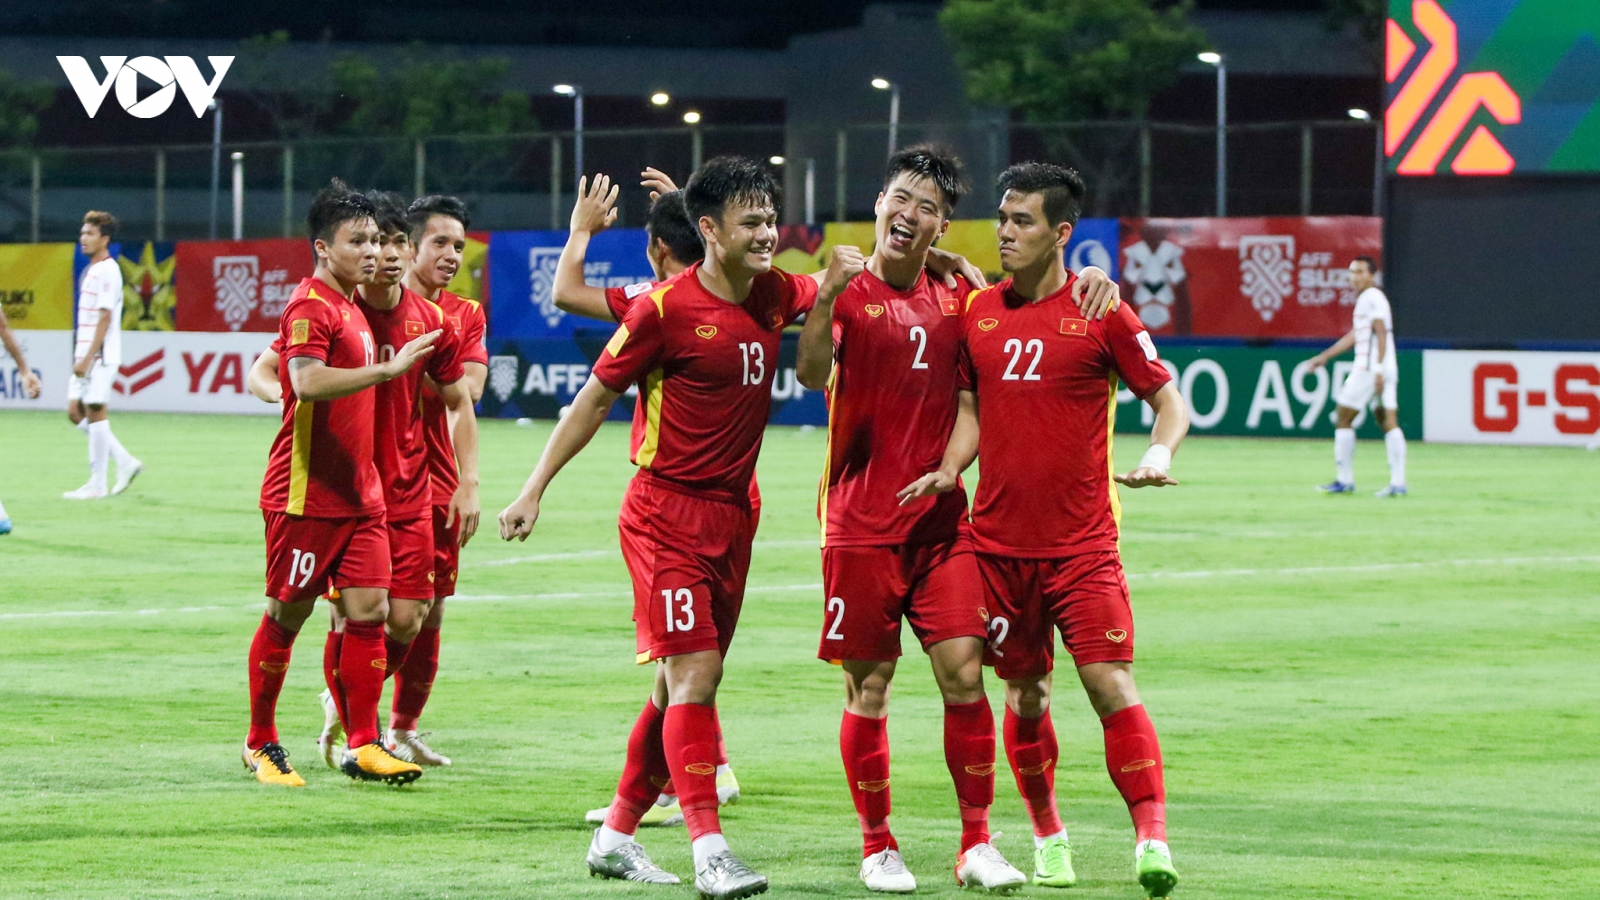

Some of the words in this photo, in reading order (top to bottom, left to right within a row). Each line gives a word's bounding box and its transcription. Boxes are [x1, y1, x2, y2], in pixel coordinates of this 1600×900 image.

[1299, 252, 1333, 266] AFF
[360, 331, 376, 366] 19
[738, 341, 765, 386] 13
[909, 326, 929, 370] 2
[1002, 338, 1044, 381] 22
[522, 363, 589, 395] AFF
[288, 548, 316, 588] 19
[661, 588, 695, 632] 13
[826, 597, 845, 640] 2
